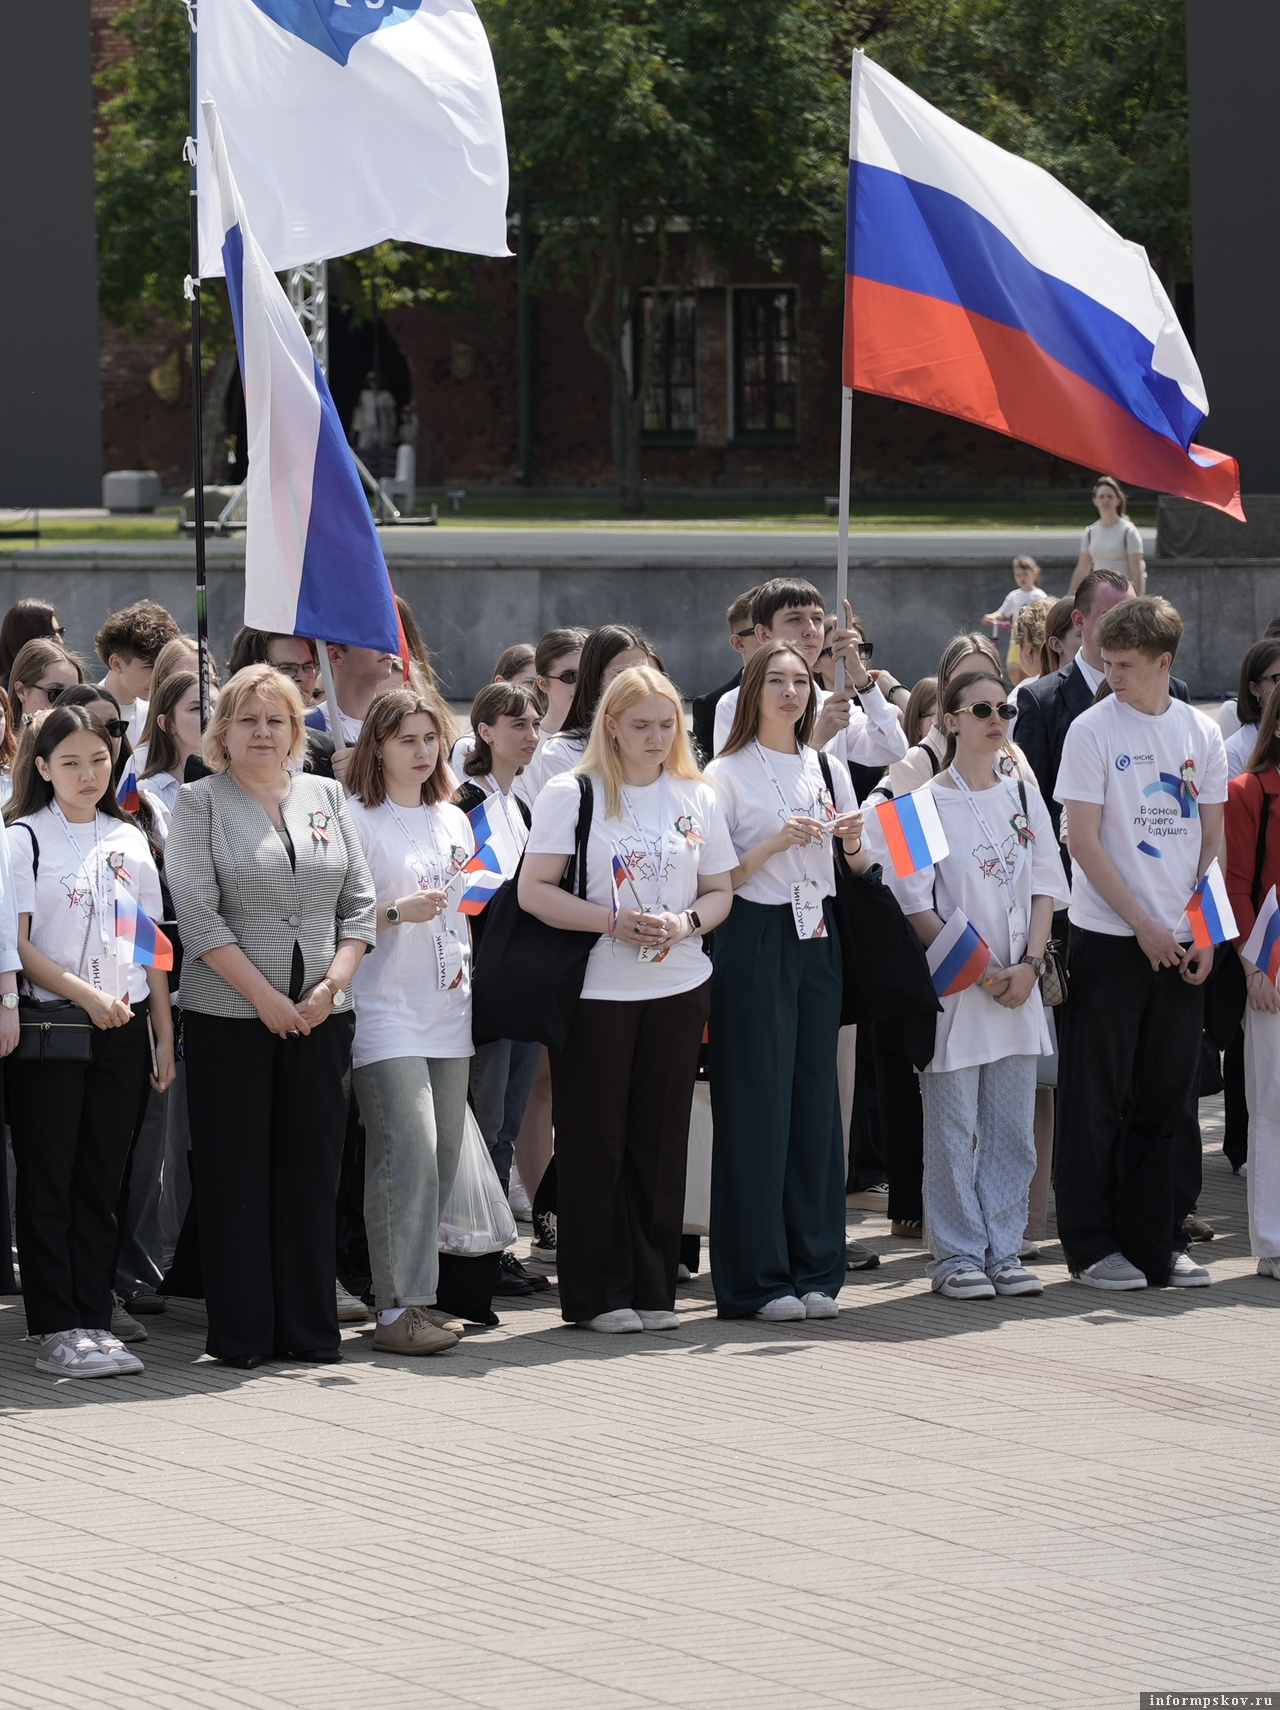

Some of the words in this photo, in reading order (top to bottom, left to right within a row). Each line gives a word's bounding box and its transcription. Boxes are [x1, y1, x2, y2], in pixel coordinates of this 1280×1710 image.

[1140, 805, 1147, 815] В
[1147, 807, 1178, 816] основе
[793, 885, 808, 938] УЧАСТНИК
[91, 957, 103, 991] СТНИК
[435, 935, 447, 989] УЧАСТНИК
